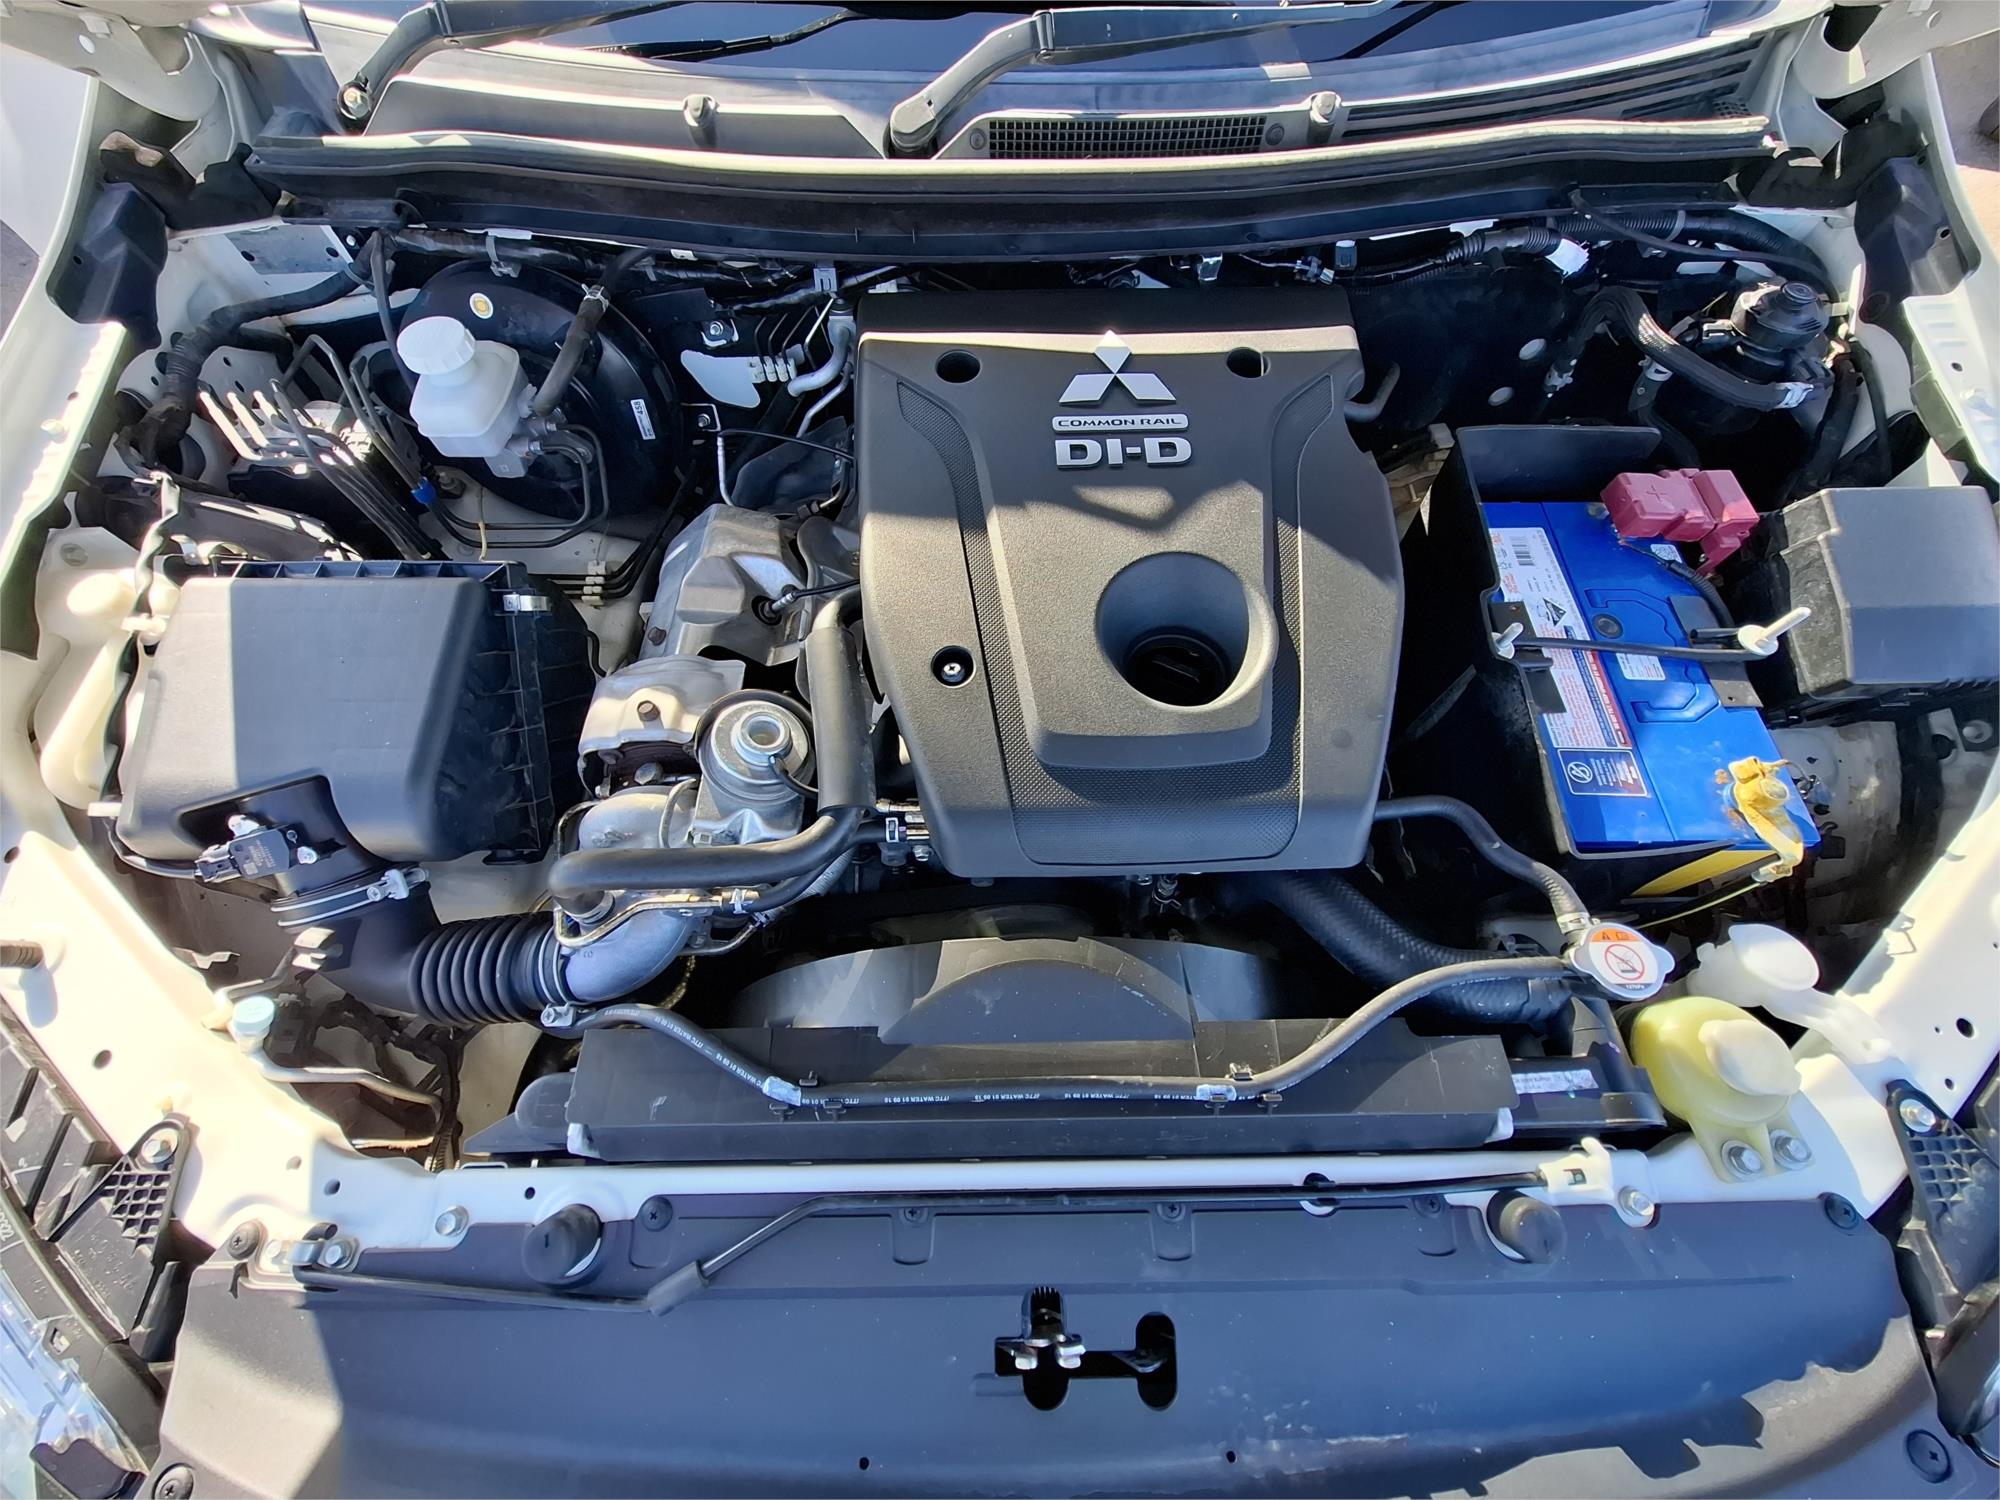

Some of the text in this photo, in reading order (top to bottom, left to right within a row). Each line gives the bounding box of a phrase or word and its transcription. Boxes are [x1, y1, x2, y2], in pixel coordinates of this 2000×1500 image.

[1058, 419, 1134, 427] COMMON
[1055, 437, 1192, 466] DI-D
[736, 1067, 757, 1085] WATER
